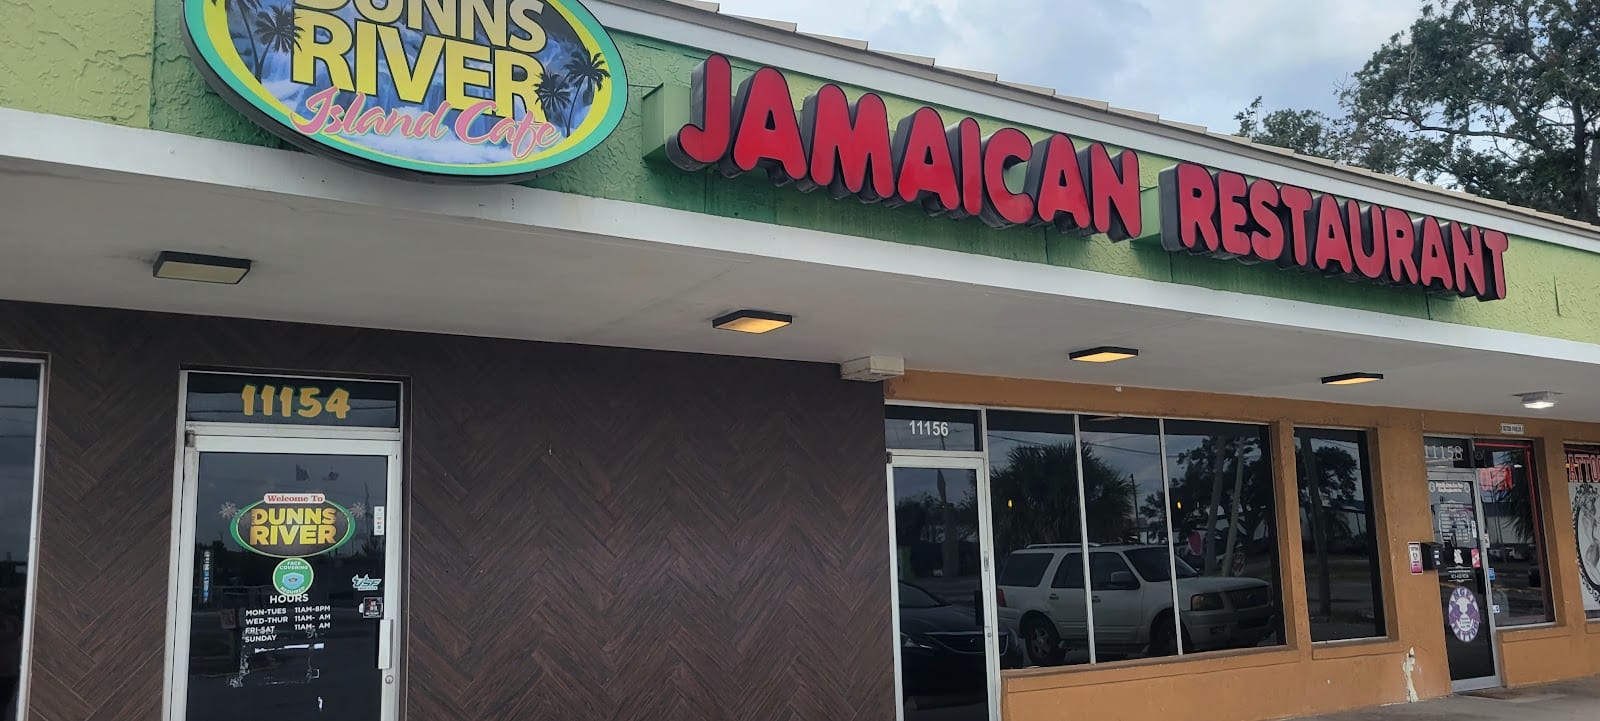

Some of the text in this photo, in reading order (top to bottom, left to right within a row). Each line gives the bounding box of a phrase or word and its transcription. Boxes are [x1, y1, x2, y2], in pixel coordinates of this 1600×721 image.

[293, 0, 547, 53] NNS
[291, 7, 547, 123] RIVER
[290, 86, 561, 159] Island Cafe
[677, 53, 1508, 300] JAMAICAN RESTAURANT
[241, 384, 350, 419] 11154
[909, 420, 949, 437] 11156
[1424, 445, 1463, 460] 11158
[1568, 454, 1600, 483] ATTO
[267, 495, 323, 503] Welcome To
[251, 508, 337, 525] DUNNS
[250, 525, 337, 545] RIVER
[269, 594, 310, 604] HOURS
[245, 605, 331, 617] MON-TUES 11AM-8PM
[245, 616, 289, 625] WED-THUR
[244, 634, 277, 643] SUNDAY
[245, 626, 276, 634] FRI-SAT
